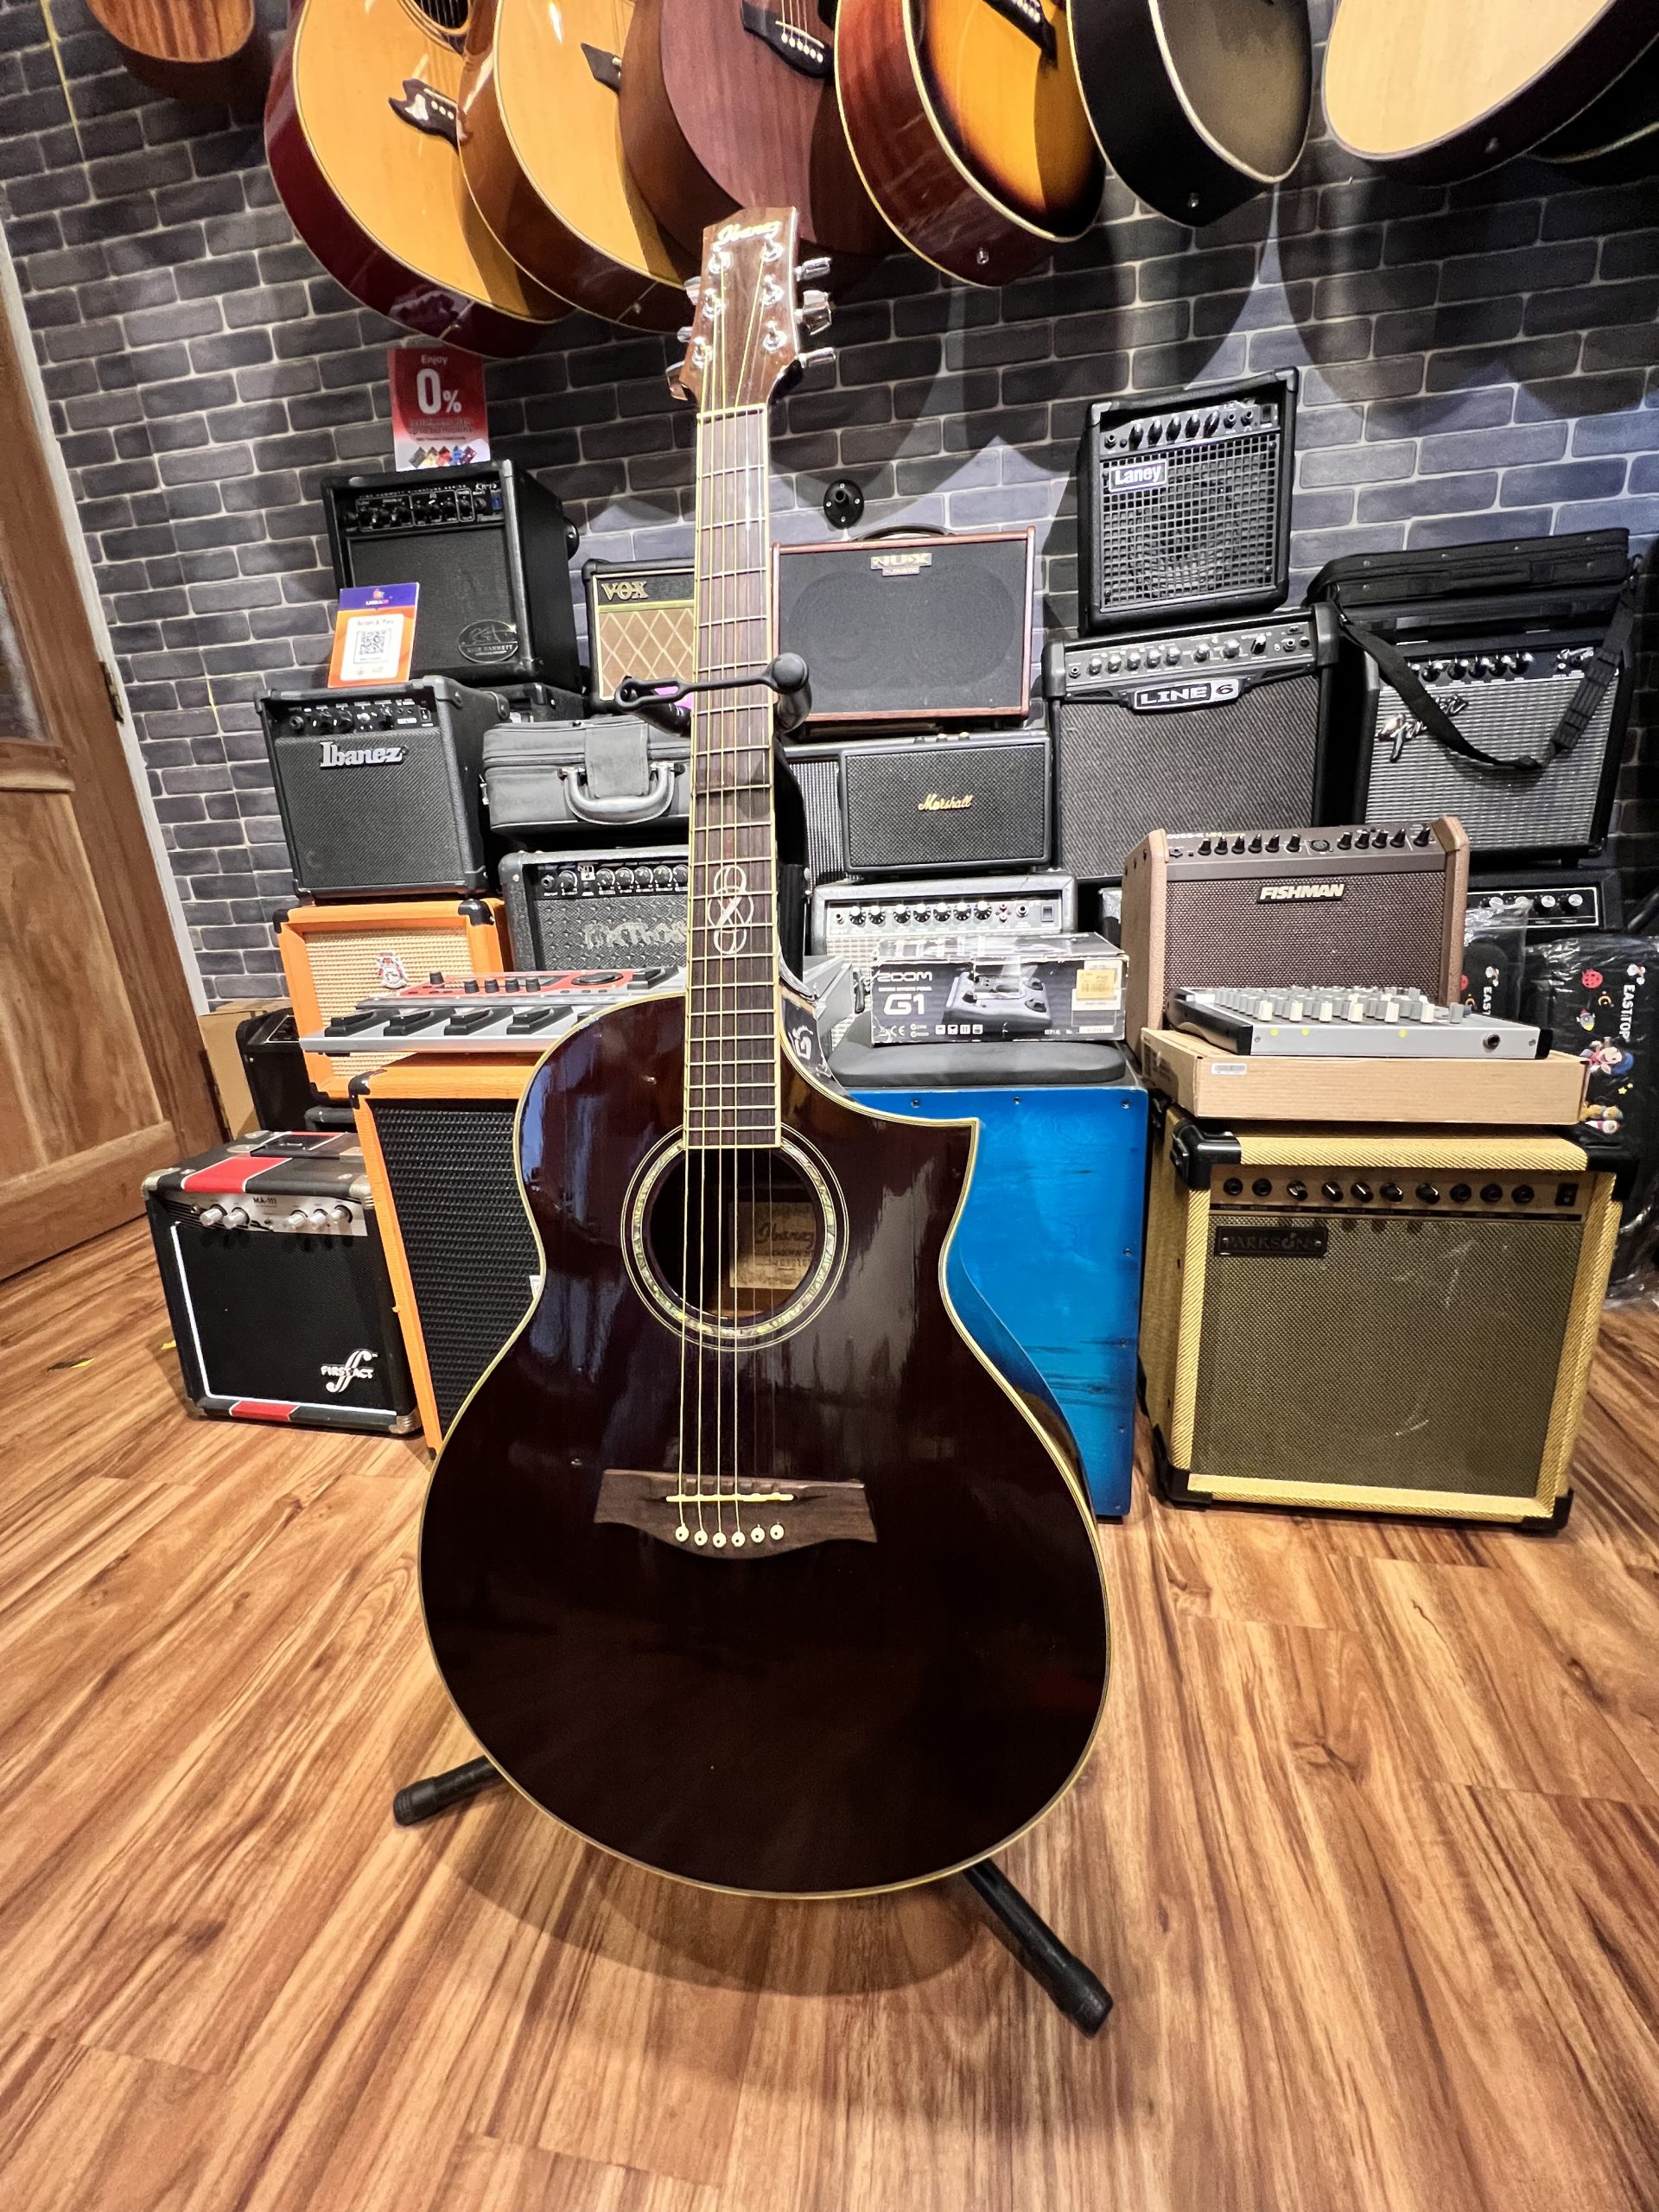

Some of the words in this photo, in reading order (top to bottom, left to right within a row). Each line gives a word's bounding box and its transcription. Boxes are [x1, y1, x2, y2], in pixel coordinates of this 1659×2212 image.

[421, 354, 448, 365] Enjoy
[416, 368, 462, 415] 0%
[1115, 465, 1162, 486] Laney
[872, 553, 931, 568] NUX
[601, 580, 649, 601] VOX
[1140, 685, 1210, 705] LINE
[1215, 683, 1235, 696] 6
[320, 741, 404, 768] Ibanez
[917, 793, 973, 810] Marshall
[1260, 884, 1344, 900] FISHMAN
[876, 971, 933, 982] ZOOM
[883, 993, 925, 1015] G1
[321, 1366, 352, 1376] FIRST
[353, 1368, 374, 1379] ACT
